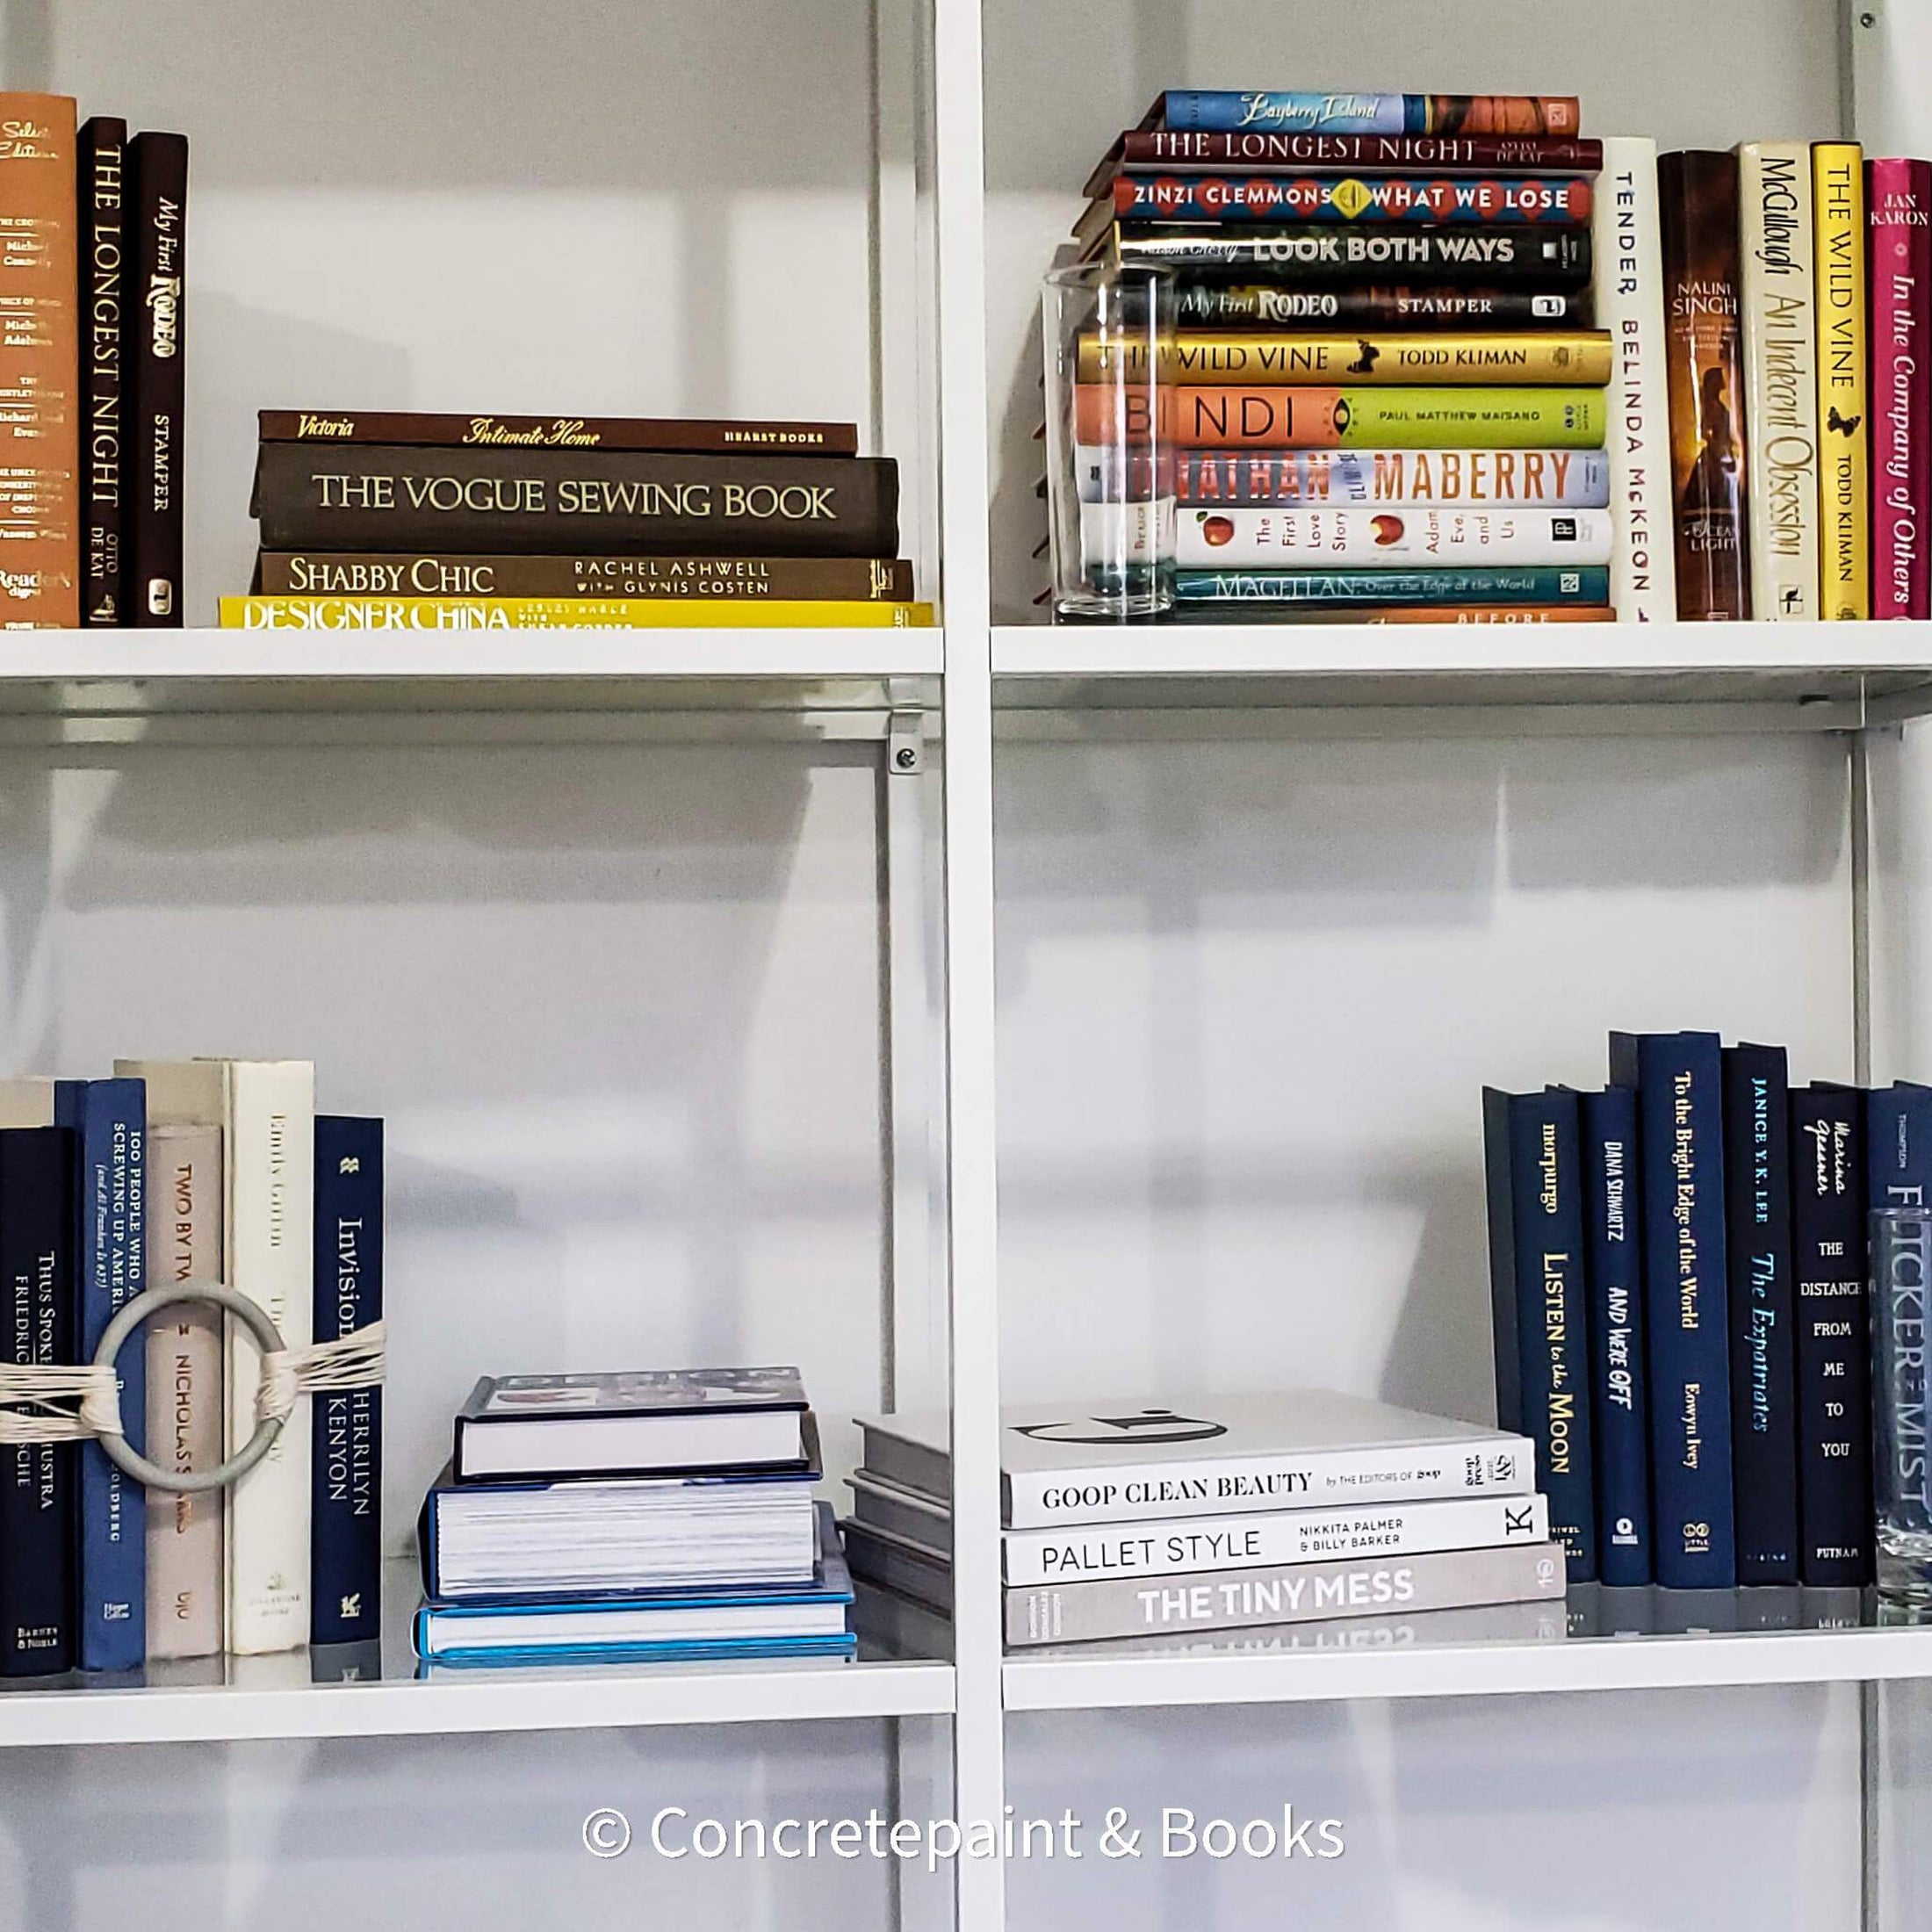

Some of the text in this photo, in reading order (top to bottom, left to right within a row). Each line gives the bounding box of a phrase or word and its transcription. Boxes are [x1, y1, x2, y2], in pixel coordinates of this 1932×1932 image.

[1236, 93, 1318, 129] Bayberry
[1150, 132, 1476, 162] THE LONGEST NIGHT
[1135, 187, 1332, 205] ZINZI CLEMMONS
[1372, 187, 1569, 209] WHAT WE LOSE
[1884, 194, 1917, 208] JAN
[153, 196, 179, 232] My
[1755, 157, 1804, 276] McCullough
[1870, 211, 1929, 227] KARON
[157, 234, 177, 272] First
[1253, 236, 1515, 263] LOOK BOTH WAYS
[1398, 298, 1493, 314] STAMPER
[1672, 296, 1737, 316] SINGH
[1677, 281, 1731, 296] NALINI
[1181, 293, 1214, 319] My
[1258, 291, 1339, 322] RODEO
[92, 145, 121, 508] THE LONGEST NIGHT
[1161, 346, 1330, 371] WILD VINE
[1398, 349, 1527, 365] TODD KLIMAN
[1827, 162, 1854, 582] THE WILD VINE TODD KLIMAN
[1616, 172, 1650, 591] TENDER BELINDA McKEON
[1764, 339, 1807, 429] Indecent
[296, 415, 355, 438] Victoria
[462, 418, 601, 446] Intimate Home
[1127, 394, 1294, 437] BINDI
[1379, 410, 1540, 422] PAUL MATTHEW MAISANO
[779, 433, 824, 444] BOOKS
[1886, 274, 1916, 604] In the Company of Others
[154, 415, 169, 512] STAMPER
[1373, 452, 1571, 501] MABERRY
[312, 474, 839, 521] THE VOGUE SEWING BOOK
[1765, 436, 1813, 557] Obsession
[1256, 517, 1272, 545] The
[1282, 515, 1296, 548] First
[1307, 513, 1322, 548] Love
[1332, 511, 1350, 551] Story
[1479, 515, 1490, 544] and
[1500, 519, 1515, 539] Us
[90, 527, 105, 579] DE KAT
[105, 534, 119, 573] OTTO
[573, 560, 771, 578] RACHEL ASHWELL
[289, 557, 496, 594] SHABBY CHIC
[624, 580, 769, 595] GLYNIS COSTEN
[1364, 580, 1396, 593] Over
[1398, 579, 1421, 593] the
[1422, 576, 1453, 596] Edge
[1470, 576, 1491, 591] the
[1495, 578, 1535, 592] World
[242, 601, 510, 630] DESIGNER CHINA
[1833, 1121, 1851, 1195] Marina
[112, 1123, 126, 1242] SCREWING UP
[129, 1168, 141, 1232] PEOPLE
[177, 1164, 192, 1246] TWO BY
[128, 1238, 141, 1280] WHO
[1743, 1078, 1775, 1432] JANICE Y. K. LEE The Expatriates
[1819, 1242, 1844, 1256] THE
[1604, 1141, 1633, 1410] DANA SCHWARTZ AND OFF
[1671, 1071, 1702, 1469] To the Bright Edge of the World Eowyn Ivey
[1539, 1124, 1575, 1474] morpurgo LISTEN to the MOON
[1800, 1282, 1862, 1296] DISTANCE
[1813, 1323, 1852, 1337] FROM
[1823, 1362, 1845, 1376] ME
[176, 1355, 192, 1461] NICHOLAS
[1825, 1402, 1844, 1417] TO
[328, 1397, 347, 1501] KENYON
[1821, 1443, 1850, 1458] YOU
[1895, 1402, 1927, 1507] MIST
[1042, 1471, 1412, 1510] GOOP CLEAN BEAUTY THE EDITORS OF
[1299, 1518, 1403, 1537] NIKKITA PALMER
[1301, 1533, 1401, 1552] & BILLY BARKER
[1042, 1530, 1261, 1574] PALLET STYLE
[1816, 1547, 1858, 1559] PUTNAM
[1137, 1568, 1416, 1624] THE TINY MESS
